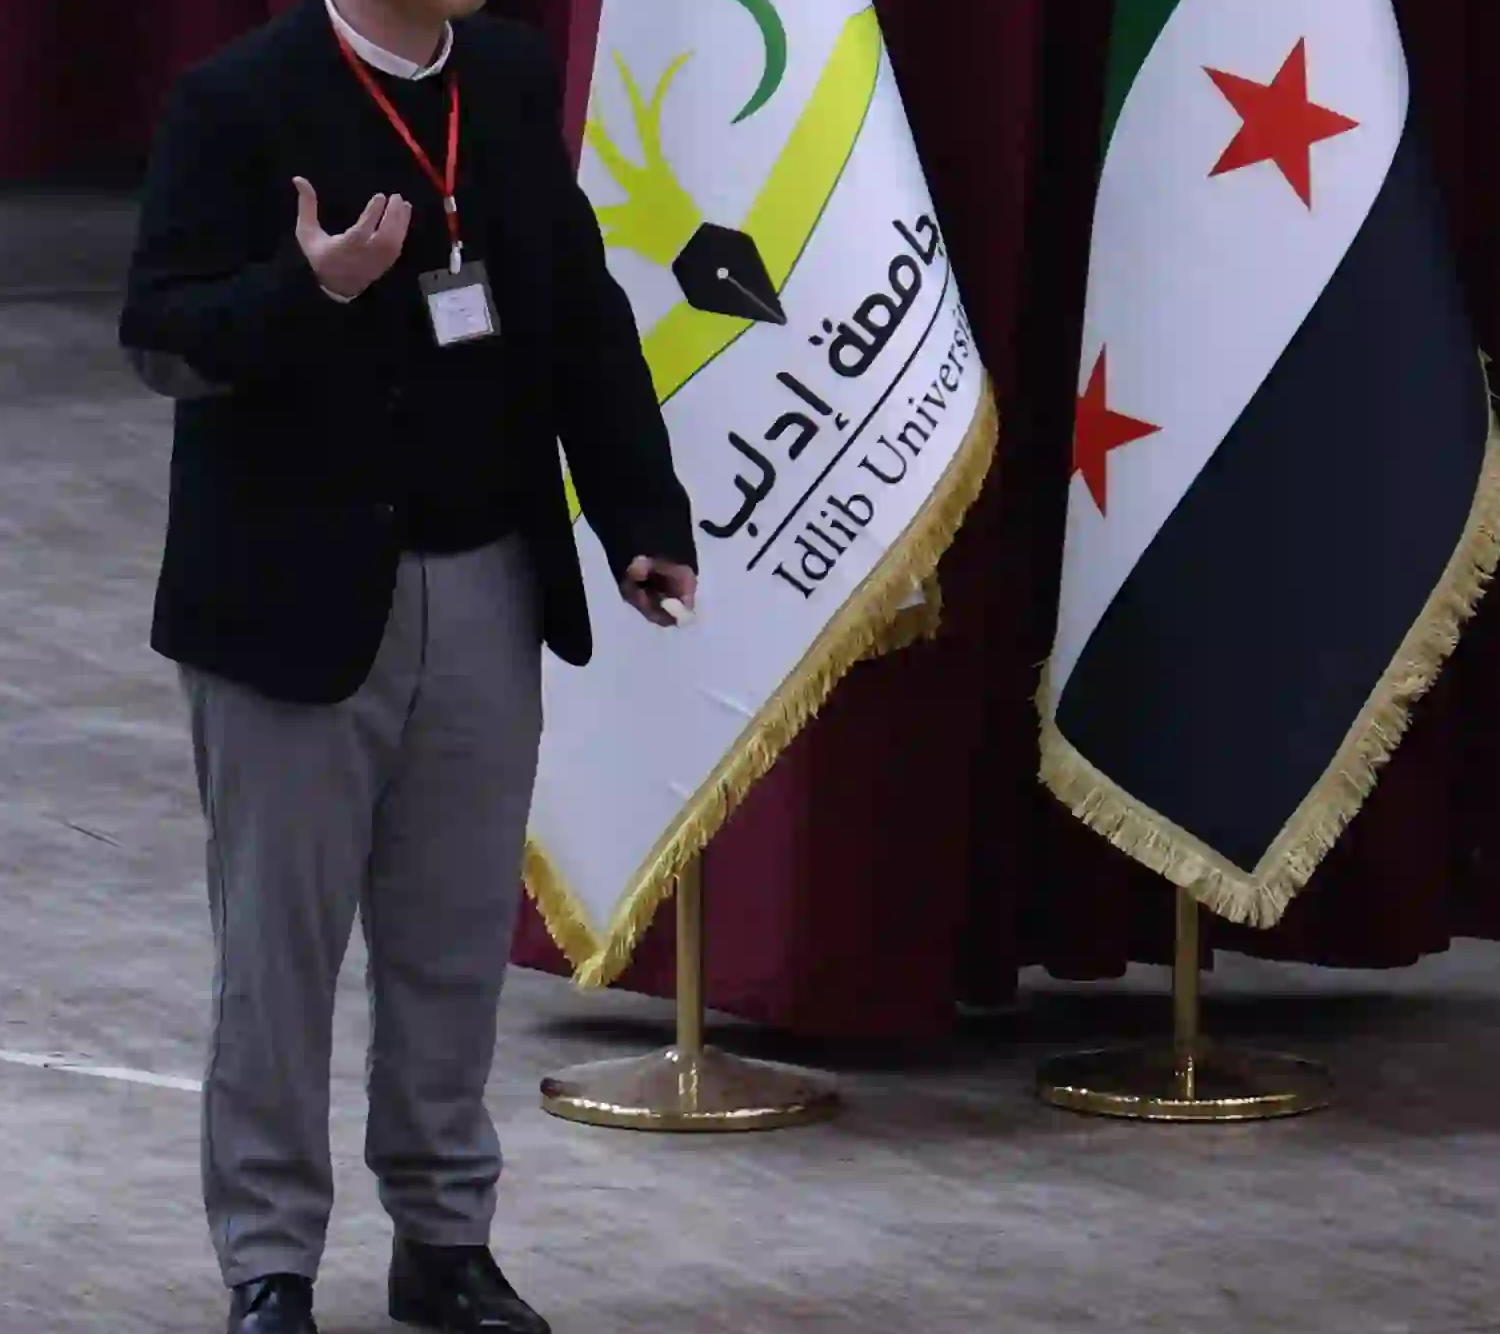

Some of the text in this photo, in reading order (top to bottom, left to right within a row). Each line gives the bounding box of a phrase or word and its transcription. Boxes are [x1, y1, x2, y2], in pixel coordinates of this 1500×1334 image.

[700, 214, 945, 539] جامعة إدلب
[773, 491, 875, 599] Idlib
